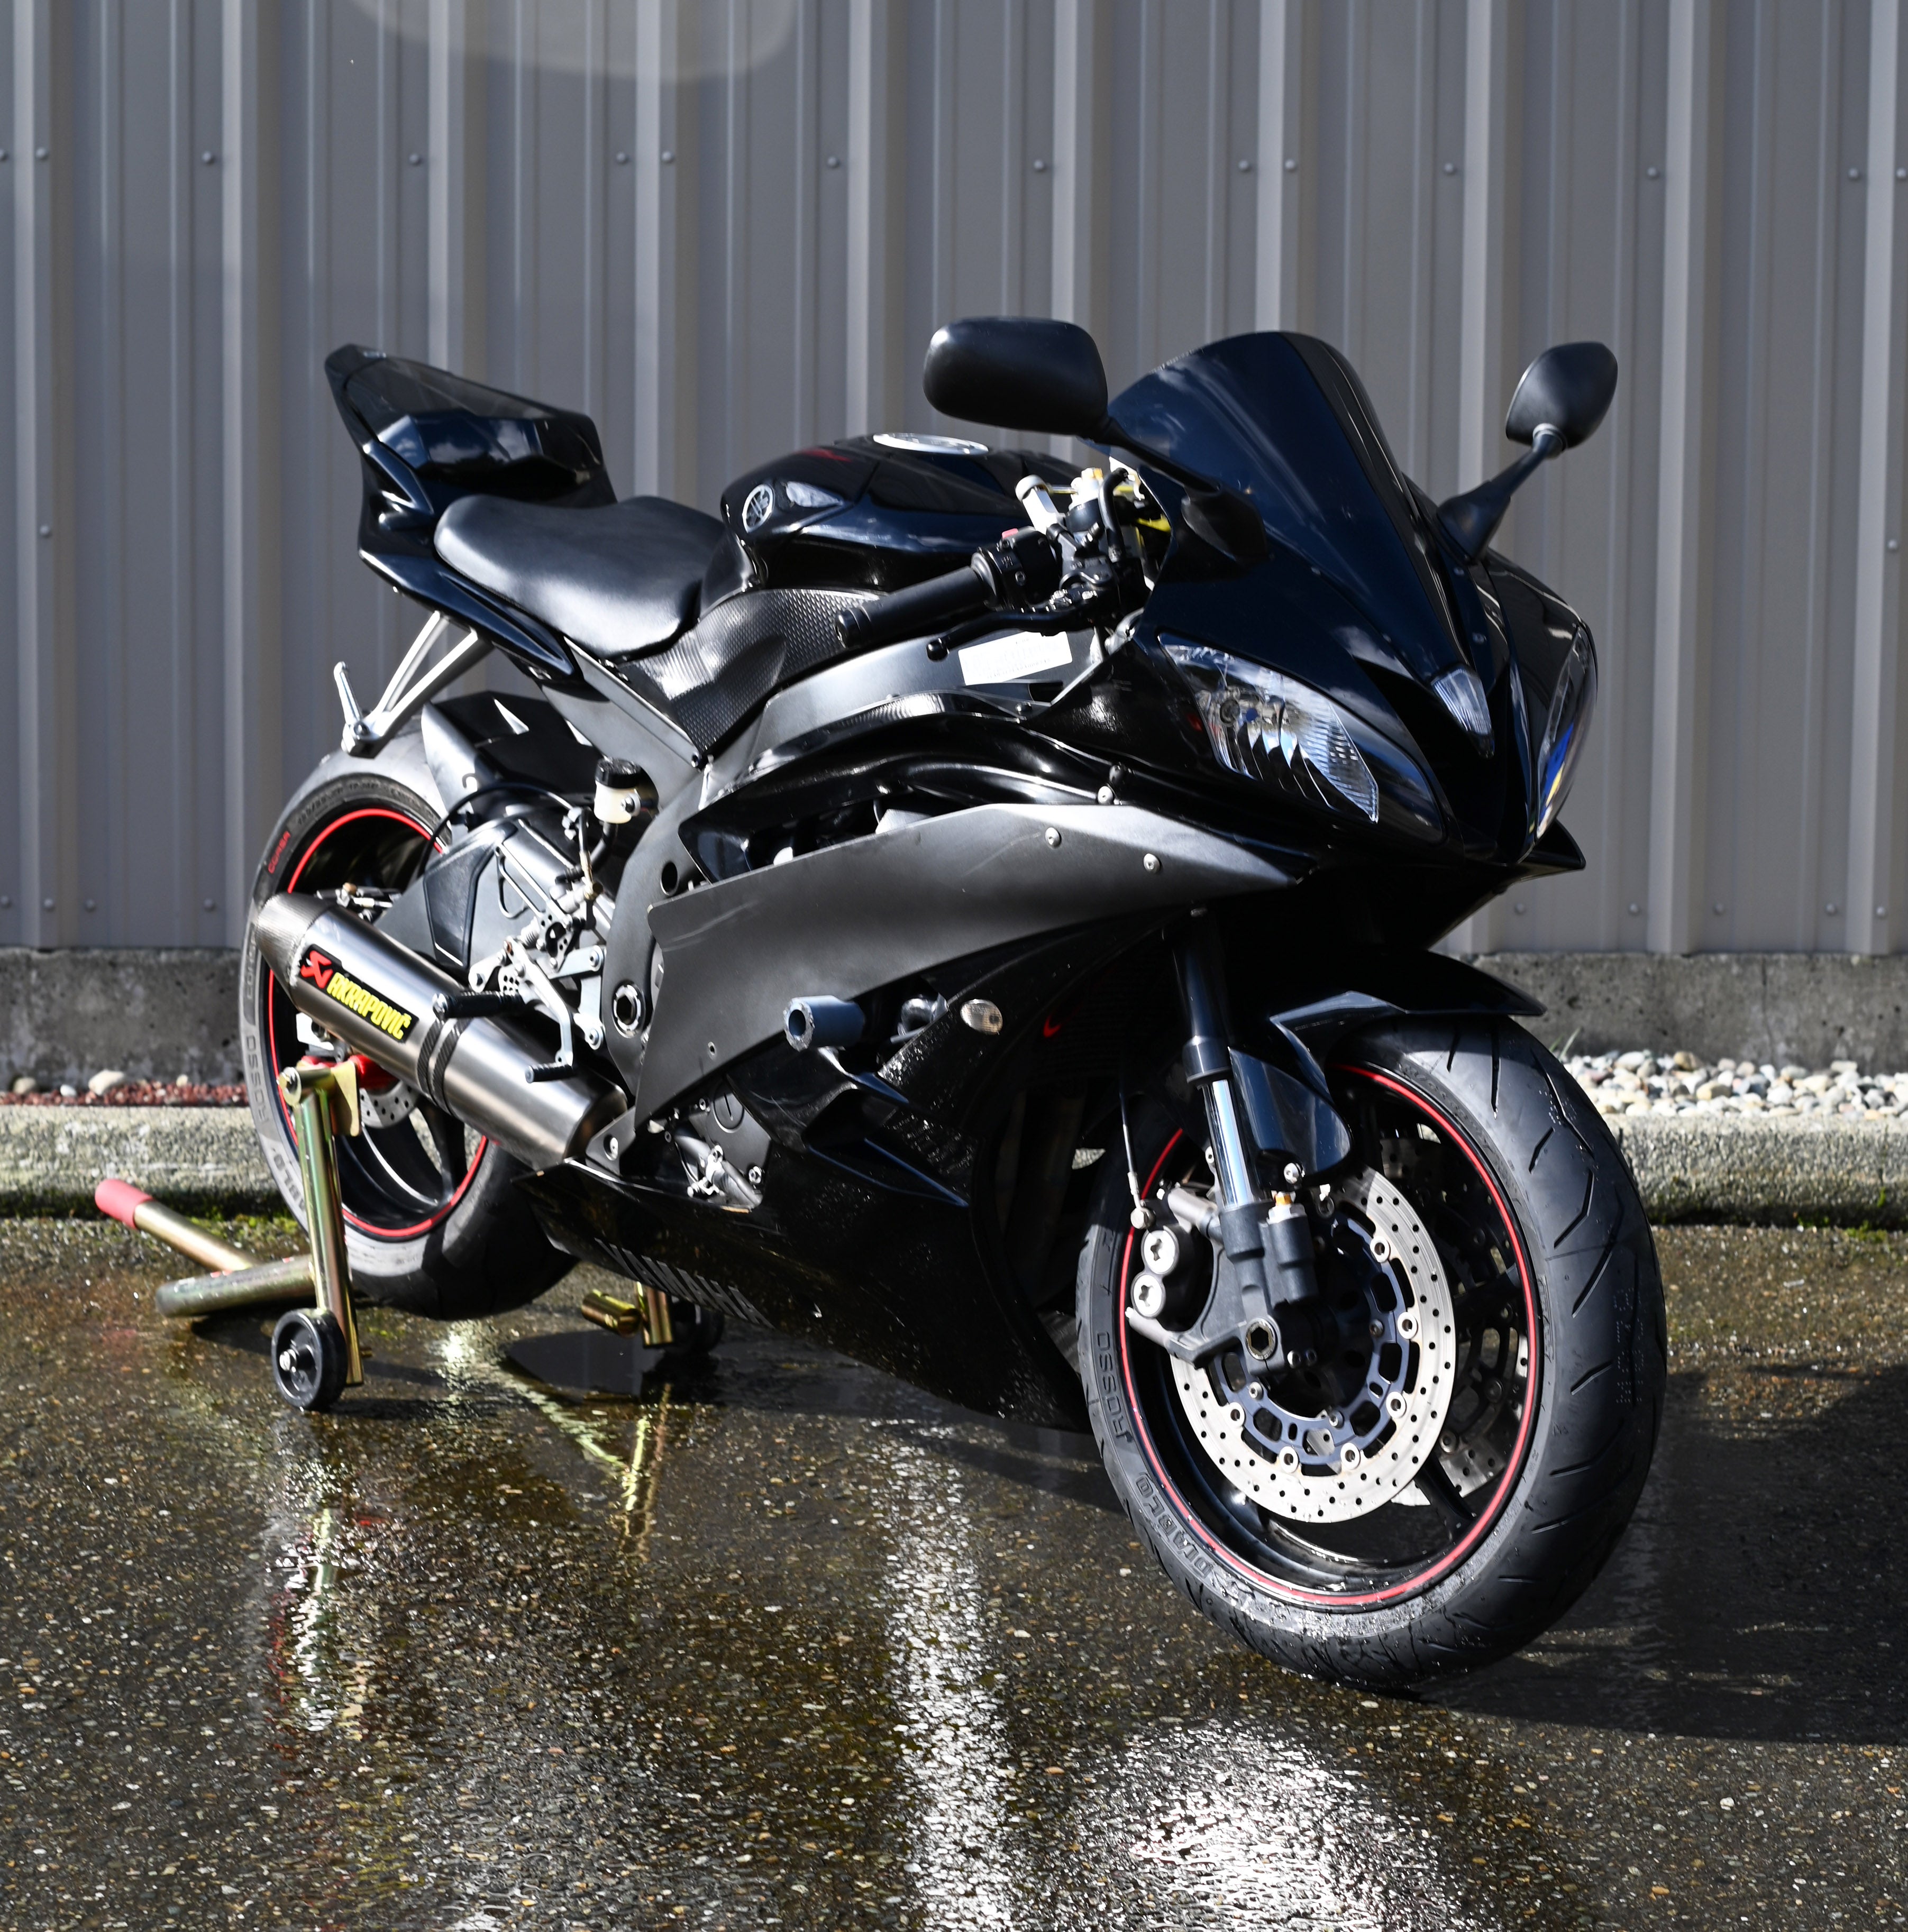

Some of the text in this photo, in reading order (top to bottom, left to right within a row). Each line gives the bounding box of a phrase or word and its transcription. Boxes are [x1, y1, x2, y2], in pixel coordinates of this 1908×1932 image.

[247, 1034, 269, 1123] ROSSO
[594, 1238, 775, 1329] YAMAHA
[1097, 1331, 1133, 1443] ROSSO
[1135, 1475, 1213, 1579] DIABLO
